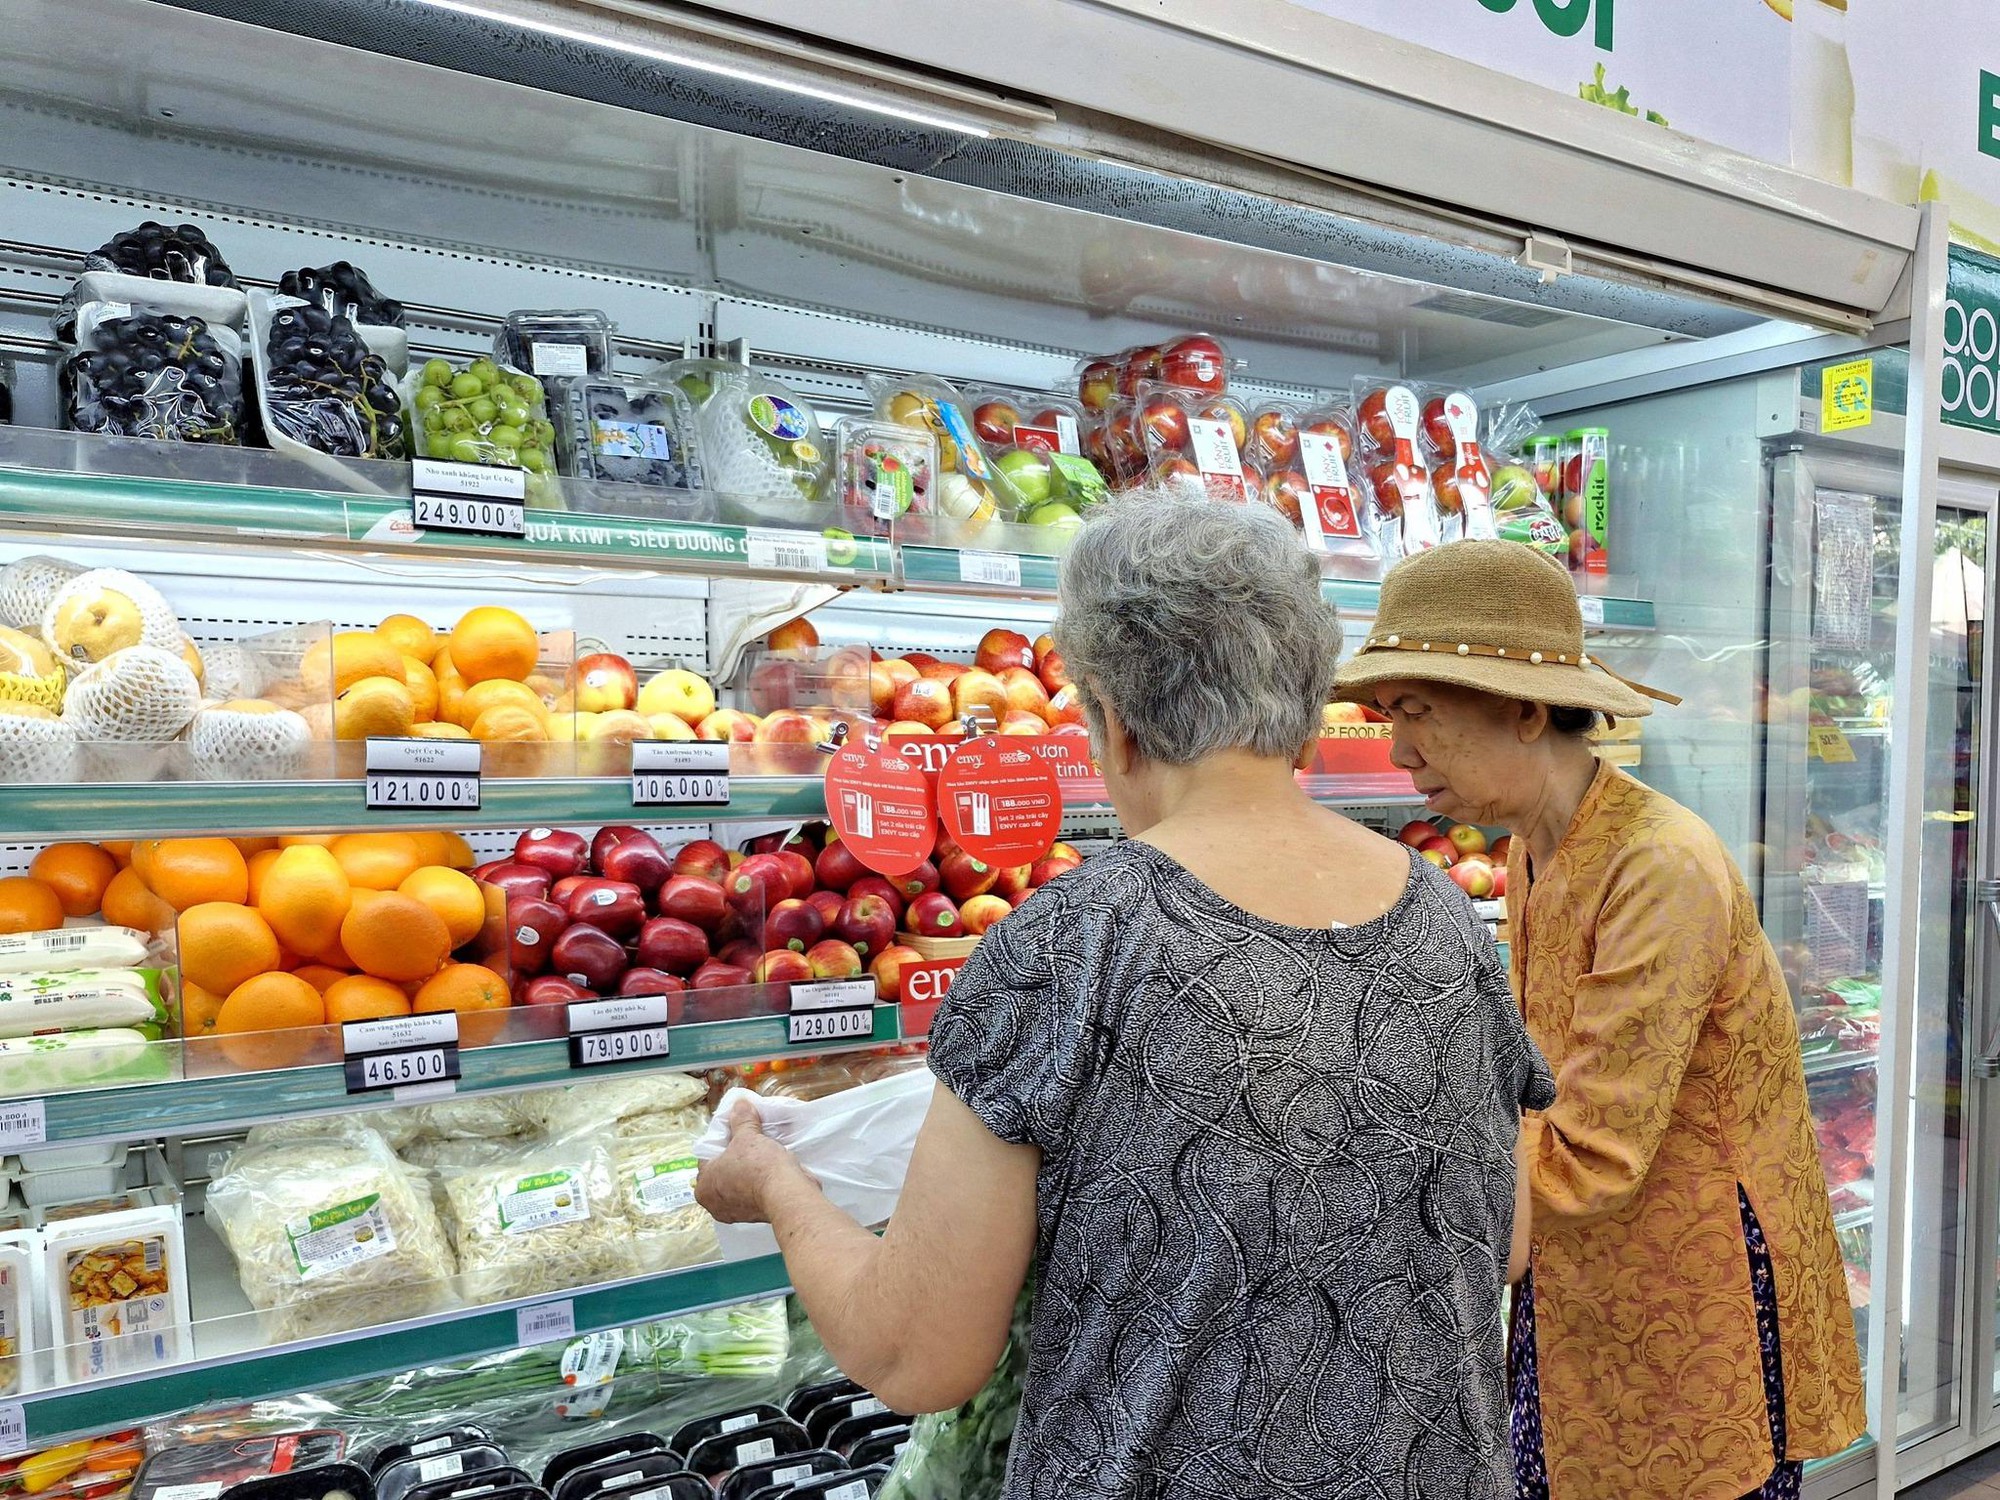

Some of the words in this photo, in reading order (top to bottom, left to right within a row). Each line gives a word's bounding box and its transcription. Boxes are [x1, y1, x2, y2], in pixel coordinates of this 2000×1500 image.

[460, 480, 480, 488] 51922
[419, 501, 505, 526] 249.000
[1591, 479, 1605, 531] rockit
[568, 527, 611, 545] KIWI
[1339, 726, 1376, 739] FOOD
[842, 752, 868, 769] envy
[956, 754, 985, 769] envy
[1056, 761, 1089, 778] tinh
[372, 781, 461, 802] 121.000
[637, 777, 713, 798] 106.000
[882, 805, 909, 816] 188.000
[910, 808, 923, 816] VND
[1001, 798, 1030, 808] 188.000
[1031, 798, 1045, 806] VND
[999, 814, 1008, 822] Set
[1000, 822, 1017, 830] ENVY
[908, 967, 962, 1001] en
[359, 1024, 376, 1033] Cam
[794, 1013, 859, 1036] 129.000
[587, 1033, 652, 1058] 79.900
[368, 1054, 442, 1081] 46.500
